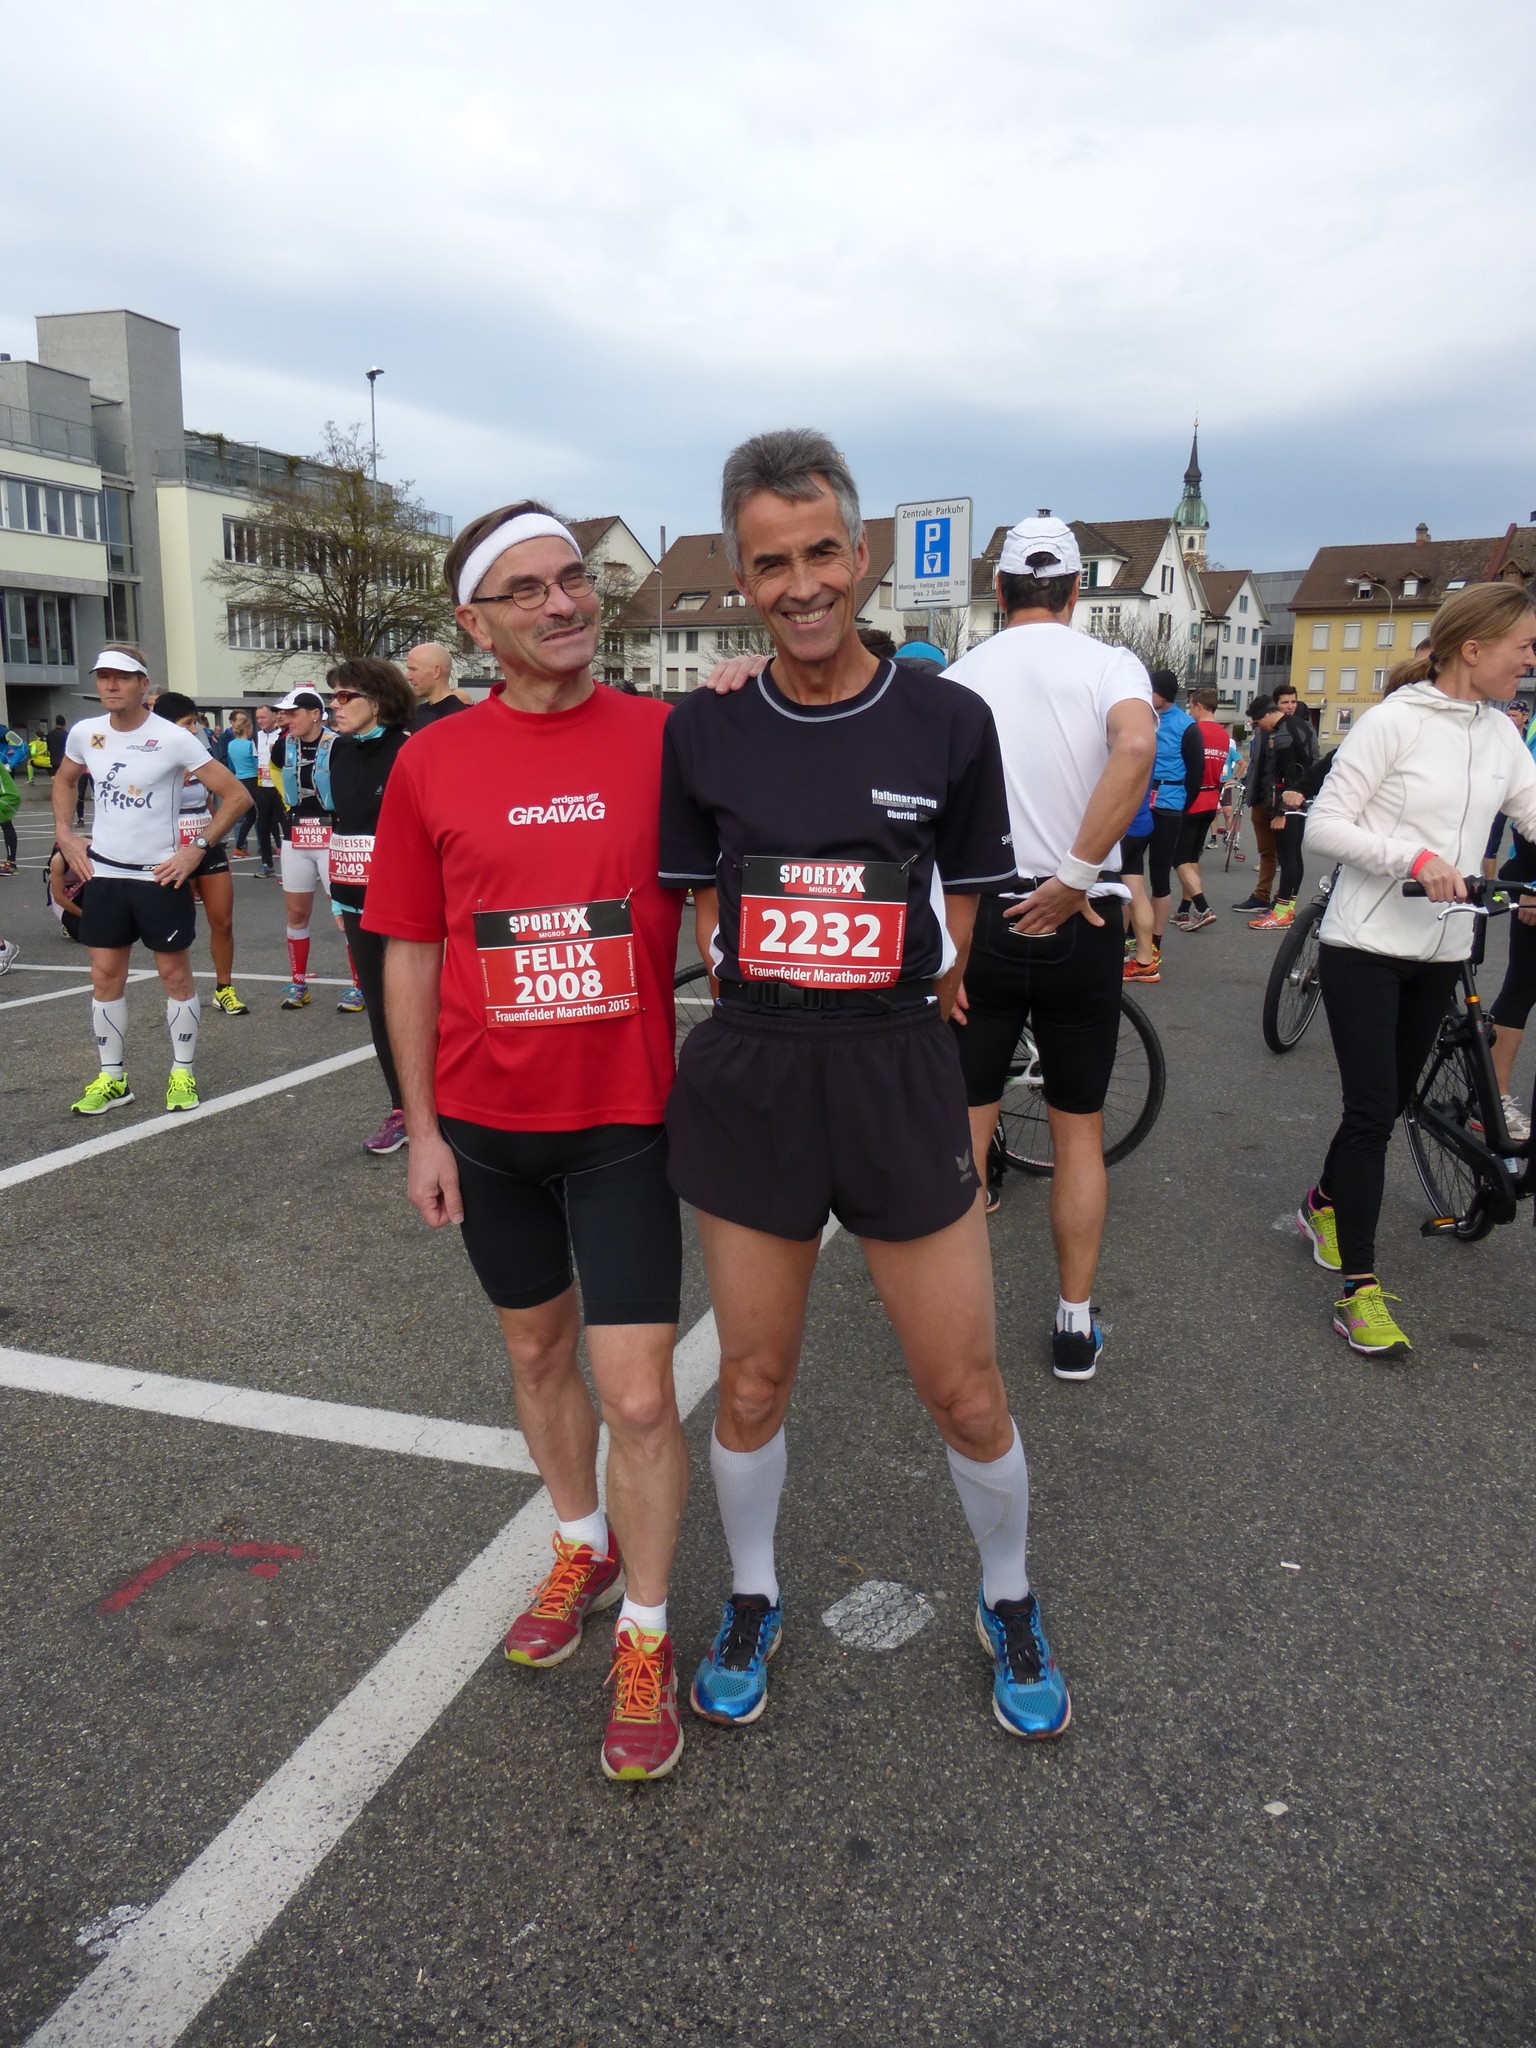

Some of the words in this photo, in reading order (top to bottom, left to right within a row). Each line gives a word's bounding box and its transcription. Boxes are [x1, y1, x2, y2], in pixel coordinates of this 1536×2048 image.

[902, 508, 932, 519] Zentrale
[936, 504, 965, 516] Parkuhr
[924, 523, 941, 552] P
[551, 795, 585, 804] erdgas
[871, 789, 937, 809] Halbmarathon
[508, 802, 606, 825] GRAVAG
[887, 810, 917, 820] Oberriet
[299, 835, 323, 843] 2158
[331, 851, 372, 862] SUSANNA
[336, 863, 365, 875] 2049
[808, 886, 837, 894] MIGROS
[760, 909, 881, 957] 2232
[514, 943, 596, 973] FELIX
[749, 964, 812, 982] Frauenfelder
[813, 969, 866, 984] Marathon
[868, 971, 891, 984] 2015
[513, 969, 603, 1004] 2008
[495, 1008, 555, 1022] Frauenfelder
[556, 1003, 607, 1018] Marathon
[608, 999, 630, 1012] 2015
